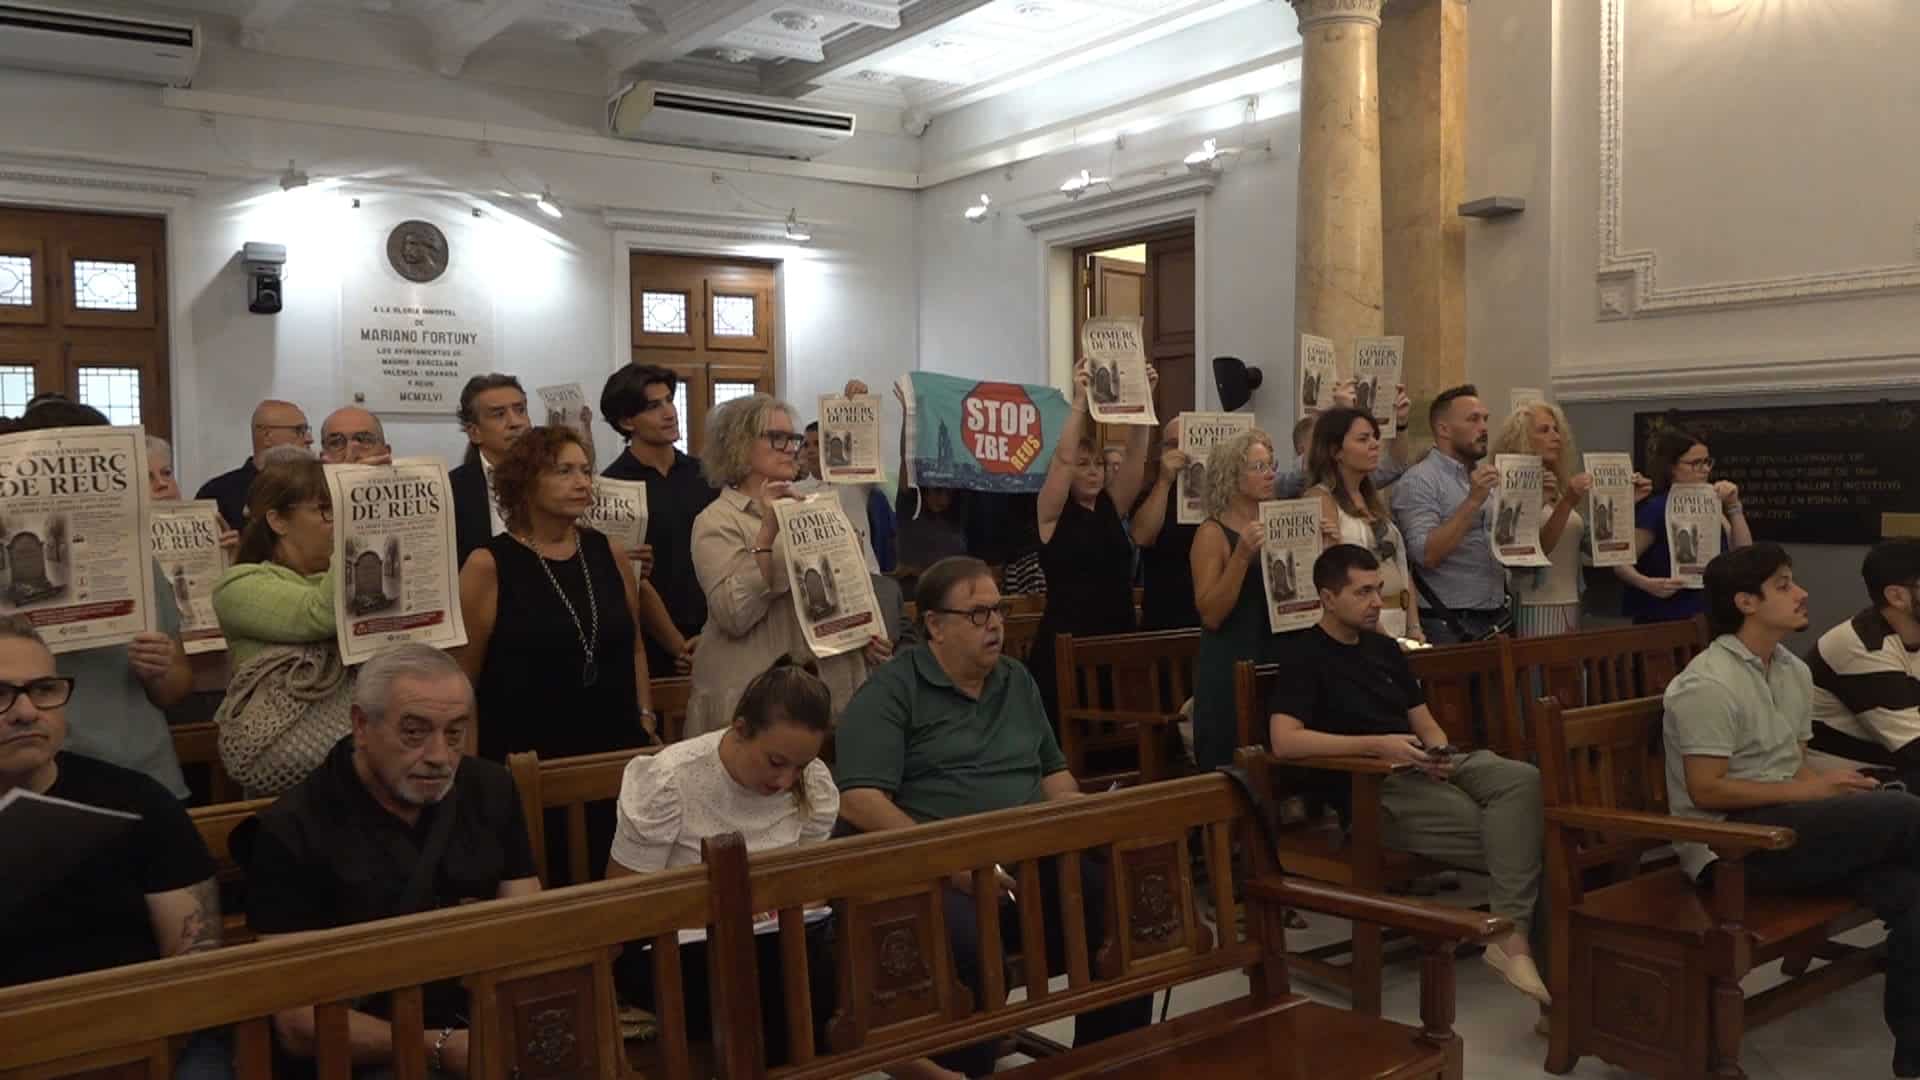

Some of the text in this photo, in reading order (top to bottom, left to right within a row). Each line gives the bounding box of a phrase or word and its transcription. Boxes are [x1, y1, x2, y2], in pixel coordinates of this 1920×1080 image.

[360, 328, 478, 345] MARIANO FORTUNY
[1091, 340, 1137, 350] DE REUS
[400, 392, 443, 401] MCMXLVI
[966, 397, 1036, 436] STOP
[974, 433, 1011, 462] ZBE
[1010, 435, 1041, 471] REUS
[0, 453, 127, 478] COMERÇ
[0, 473, 128, 498] DE REUS
[350, 481, 441, 503] COMERÇ
[352, 497, 440, 521] DE REUS
[151, 519, 210, 537] OMERÇ
[791, 523, 847, 546] DE REUS
[1270, 529, 1284, 541] DE
[171, 534, 215, 550] REUS
